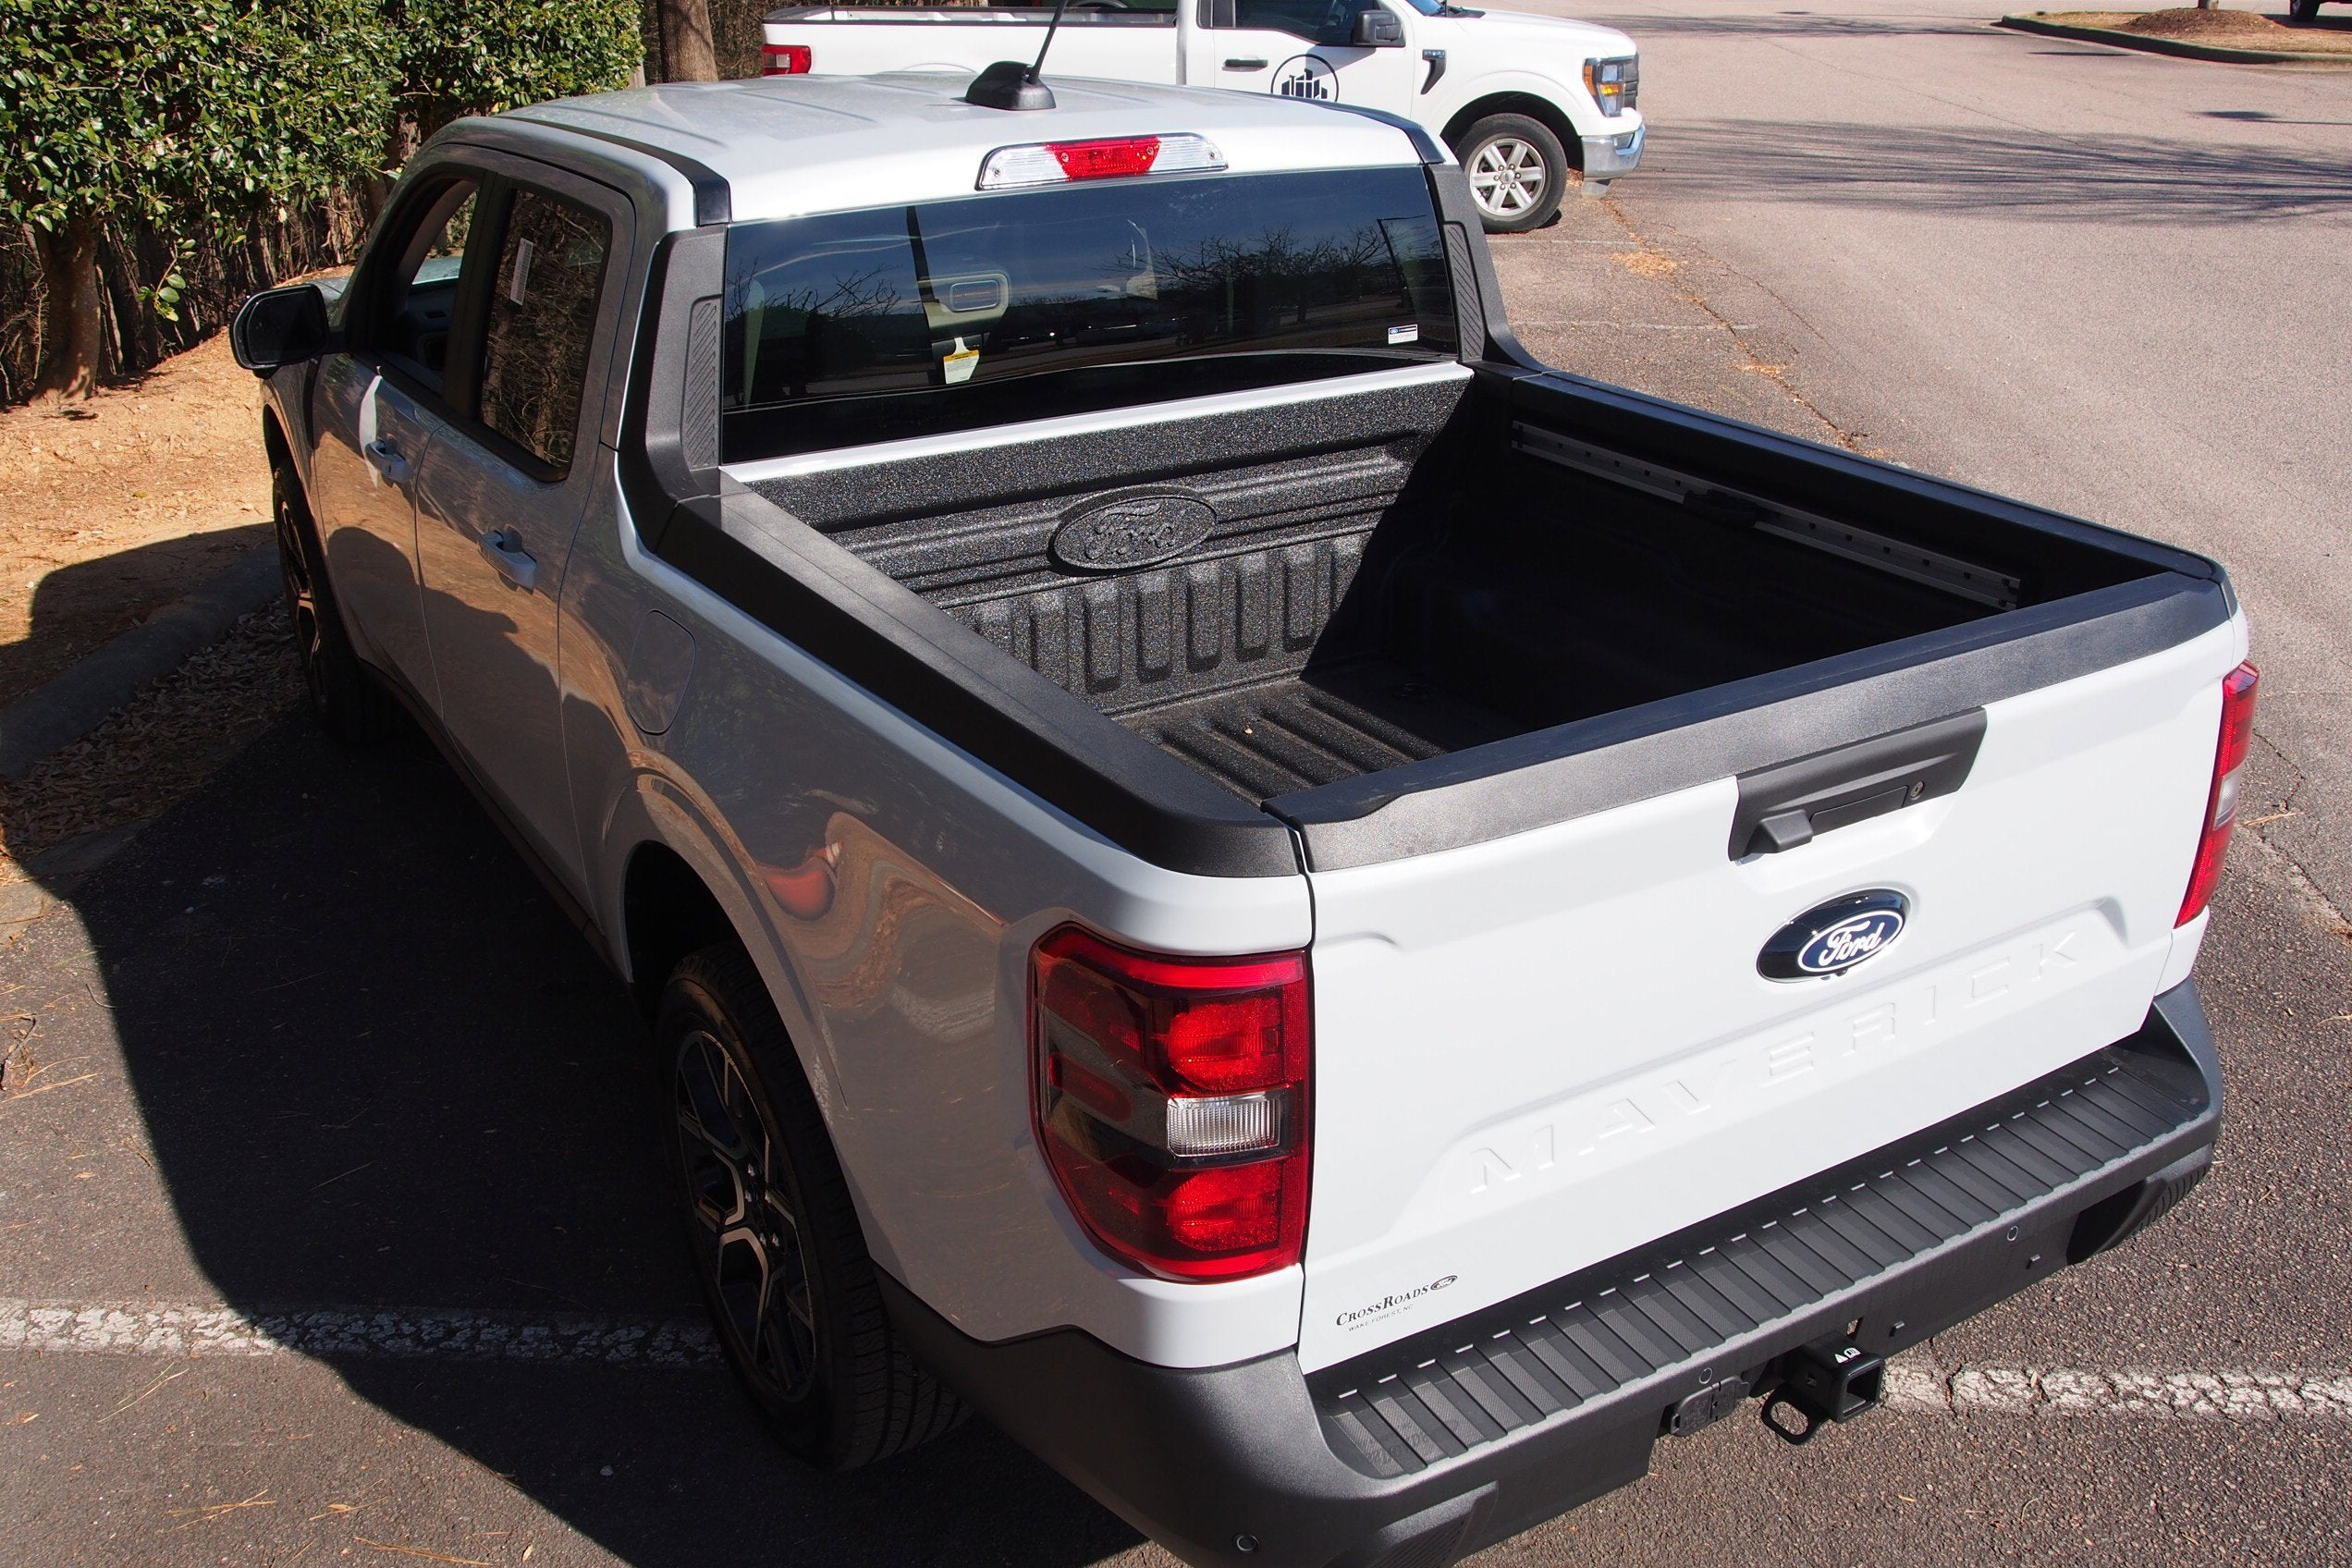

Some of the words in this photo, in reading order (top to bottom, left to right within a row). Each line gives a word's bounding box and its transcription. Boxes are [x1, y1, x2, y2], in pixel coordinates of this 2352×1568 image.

[1084, 500, 1183, 560] Ford
[1819, 920, 1885, 966] Ford
[1470, 930, 2078, 1194] MAVERICK
[1348, 1321, 1369, 1331] WAKE
